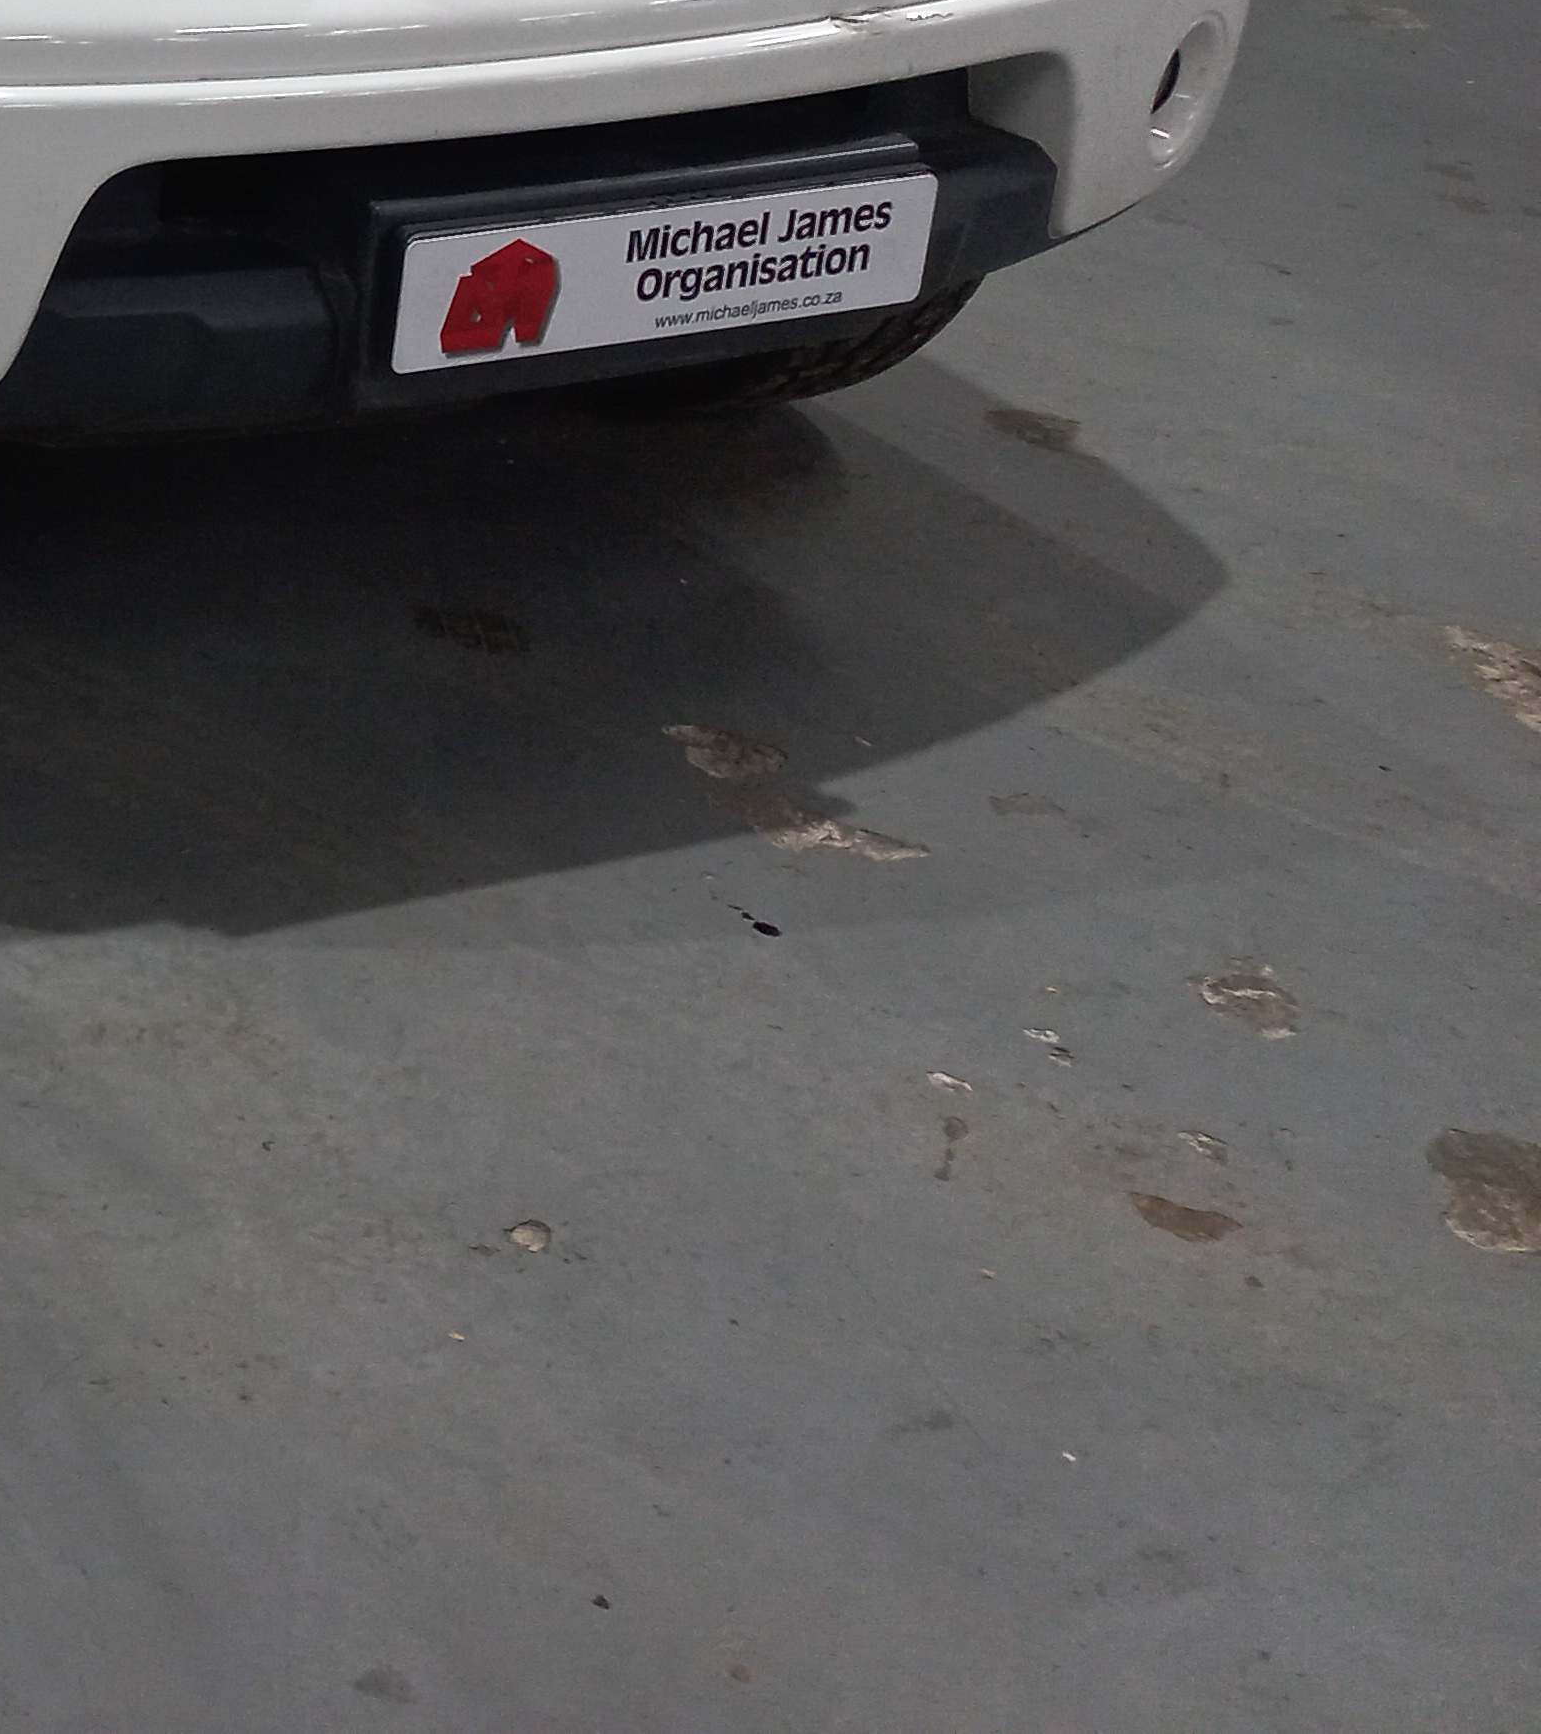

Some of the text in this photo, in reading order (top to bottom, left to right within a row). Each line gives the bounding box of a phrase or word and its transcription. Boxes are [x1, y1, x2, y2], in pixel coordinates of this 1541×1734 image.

[625, 201, 892, 263] Michael James
[636, 243, 870, 302] Organisation
[654, 291, 842, 329] www.michaeljames.co.za
